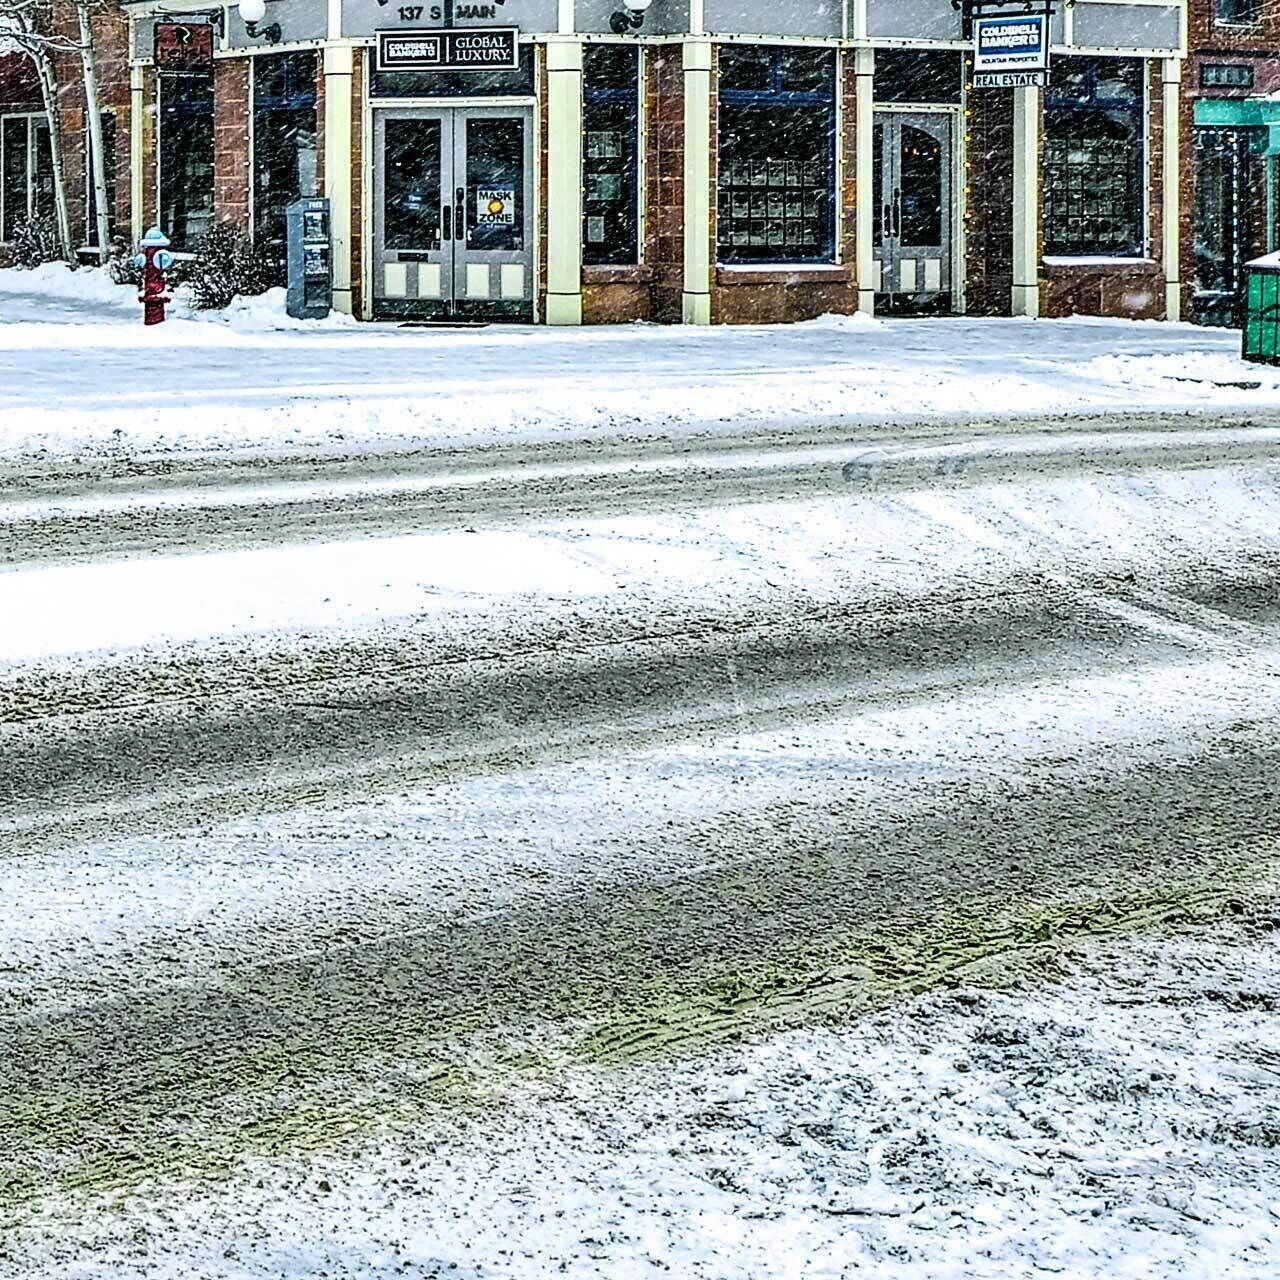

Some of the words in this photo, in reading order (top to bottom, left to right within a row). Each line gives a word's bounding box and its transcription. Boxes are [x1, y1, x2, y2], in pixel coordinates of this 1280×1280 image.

[397, 6, 424, 20] 137
[456, 5, 496, 19] MAIN
[981, 24, 1039, 37] COLDWELL
[388, 41, 436, 51] COLDWELL
[455, 36, 507, 49] GLOBAL
[981, 35, 1029, 48] BANKER
[389, 49, 428, 58] BANKER
[975, 75, 1000, 87] REAL
[1002, 73, 1039, 86] ESTATE
[479, 191, 512, 201] MASK
[479, 213, 512, 223] ZONE
